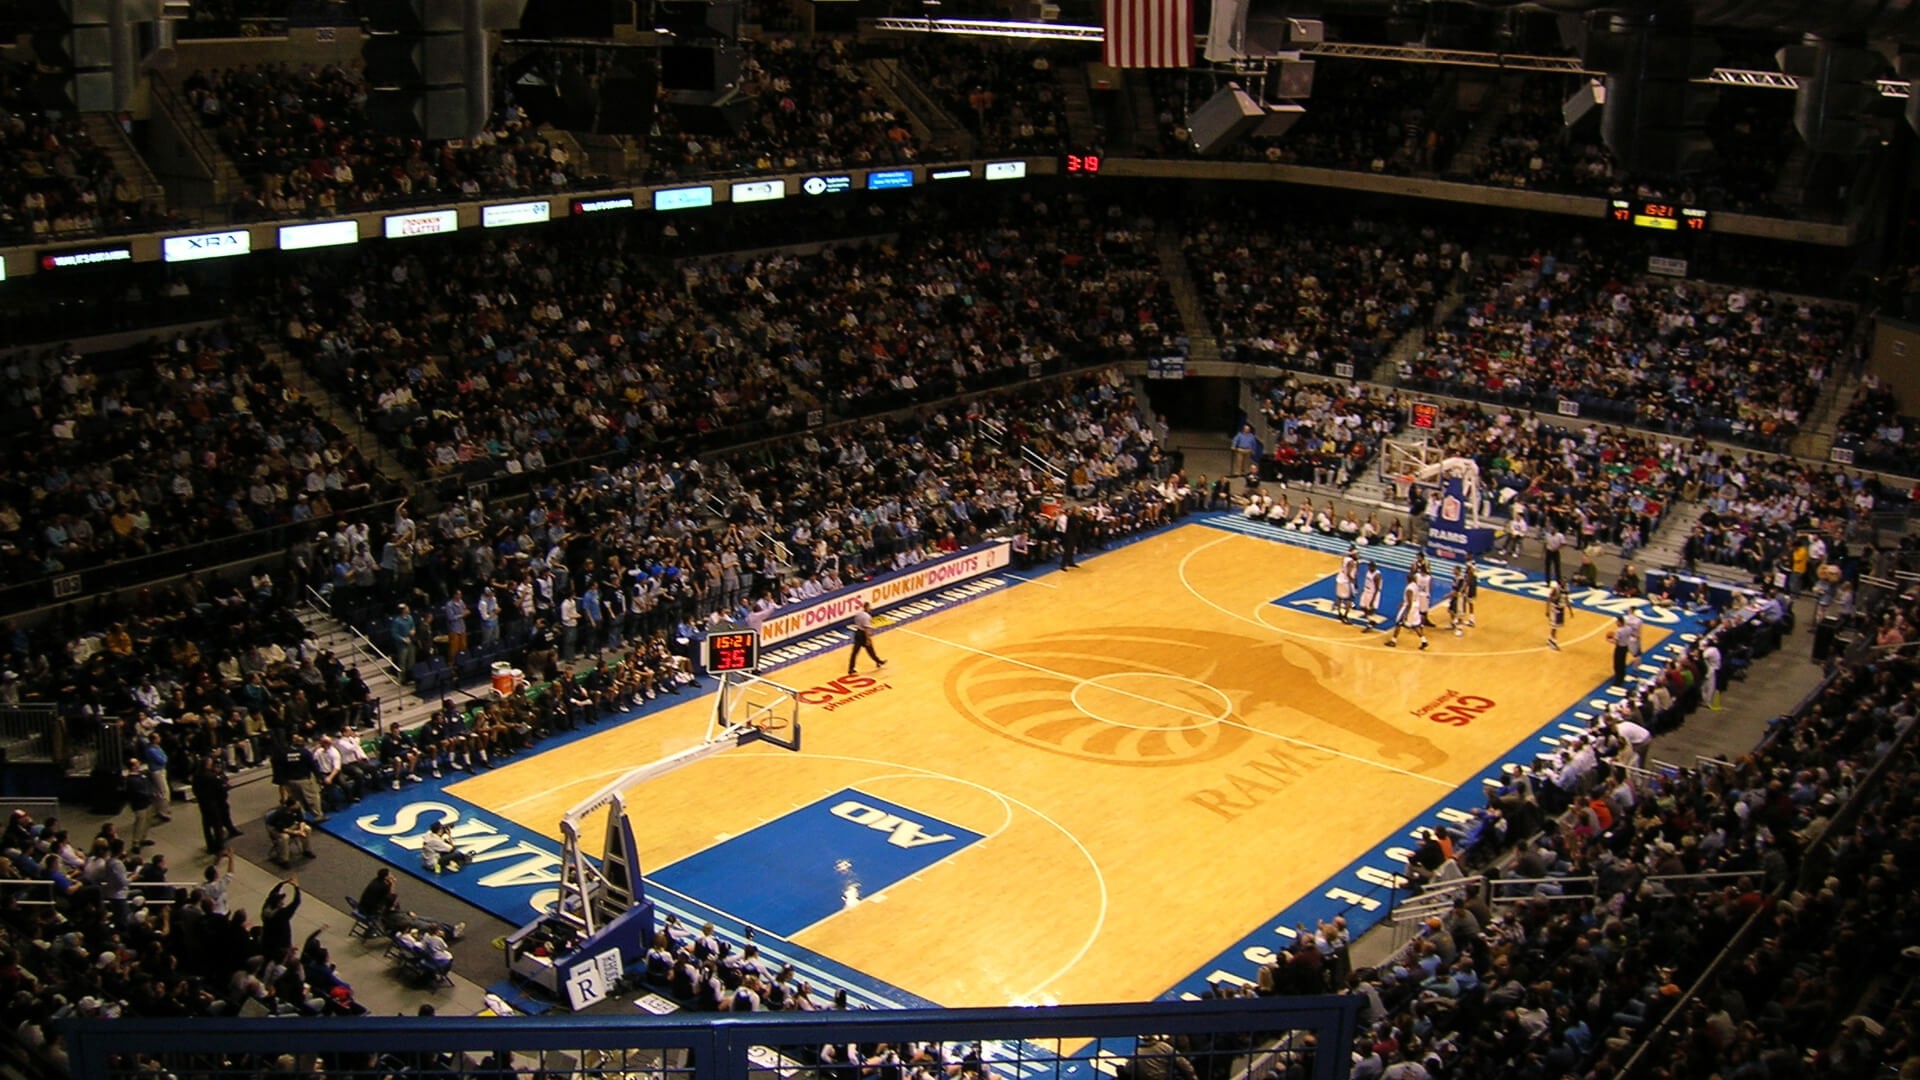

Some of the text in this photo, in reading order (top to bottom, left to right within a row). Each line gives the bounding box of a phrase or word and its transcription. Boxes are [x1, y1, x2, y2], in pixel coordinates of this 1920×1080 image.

[1068, 155, 1098, 171] 3:19
[1614, 209, 1630, 220] 47
[1687, 218, 1704, 229] 47
[872, 556, 978, 603] DUNKIN' DONUTS
[757, 630, 850, 670] IVERSITY
[935, 577, 1006, 602] ISLAND
[762, 595, 863, 641] NKIN' DONUTS
[716, 634, 752, 649] 15:21
[716, 649, 746, 669] 35
[797, 674, 877, 705] CVS
[1429, 695, 1496, 727] CVS
[1184, 735, 1341, 823] RAMS
[576, 978, 598, 1003] R
